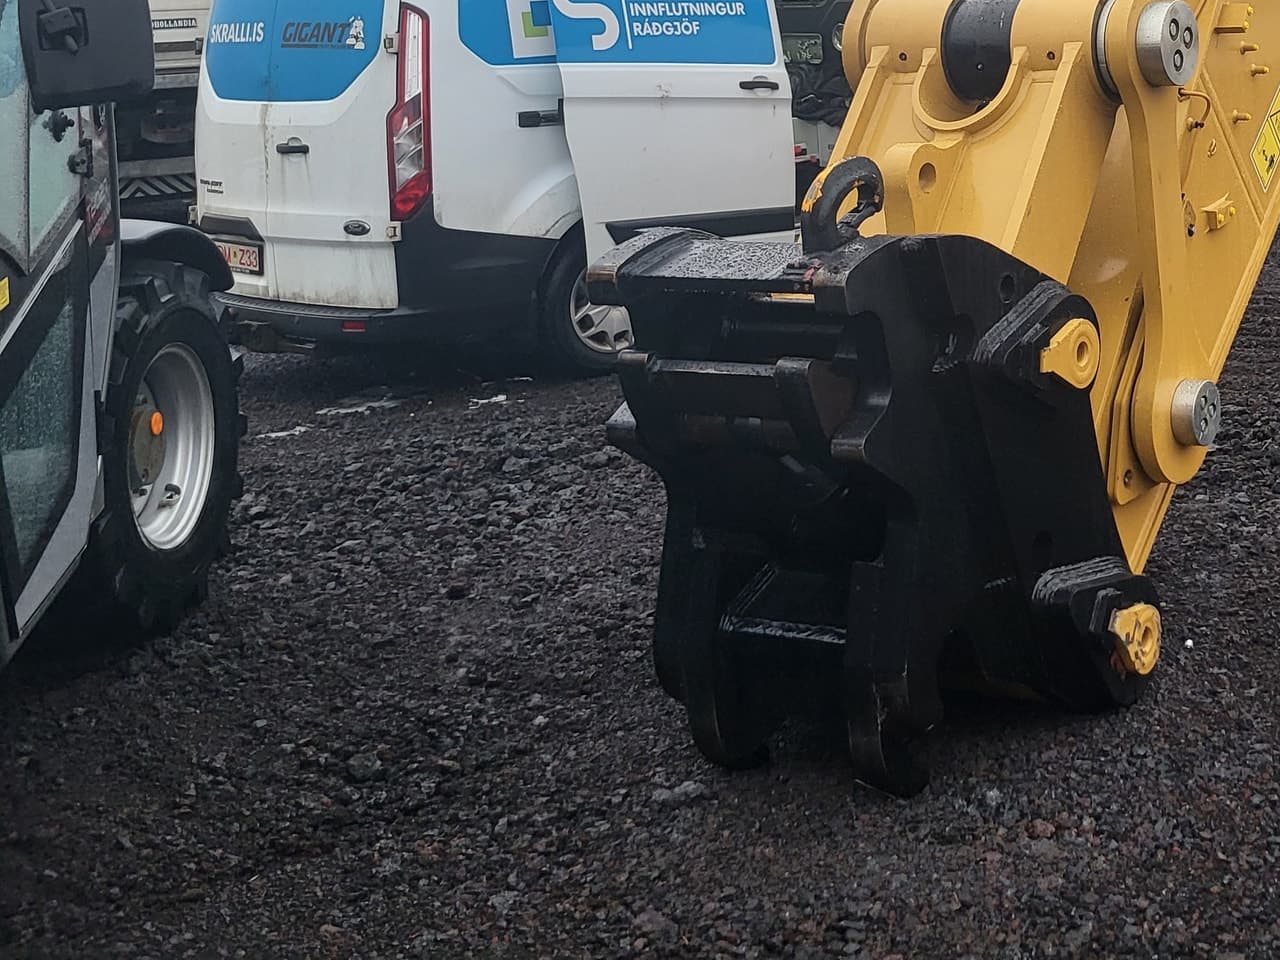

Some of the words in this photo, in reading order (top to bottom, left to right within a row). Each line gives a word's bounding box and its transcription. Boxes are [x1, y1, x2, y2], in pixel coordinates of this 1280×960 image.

[629, 1, 746, 16] INNFLUTNINGUR
[210, 21, 265, 43] SKRALLI.IS
[281, 21, 351, 43] GIGANT
[632, 18, 701, 36] RÁÐGJÖF
[239, 248, 258, 268] Z33
